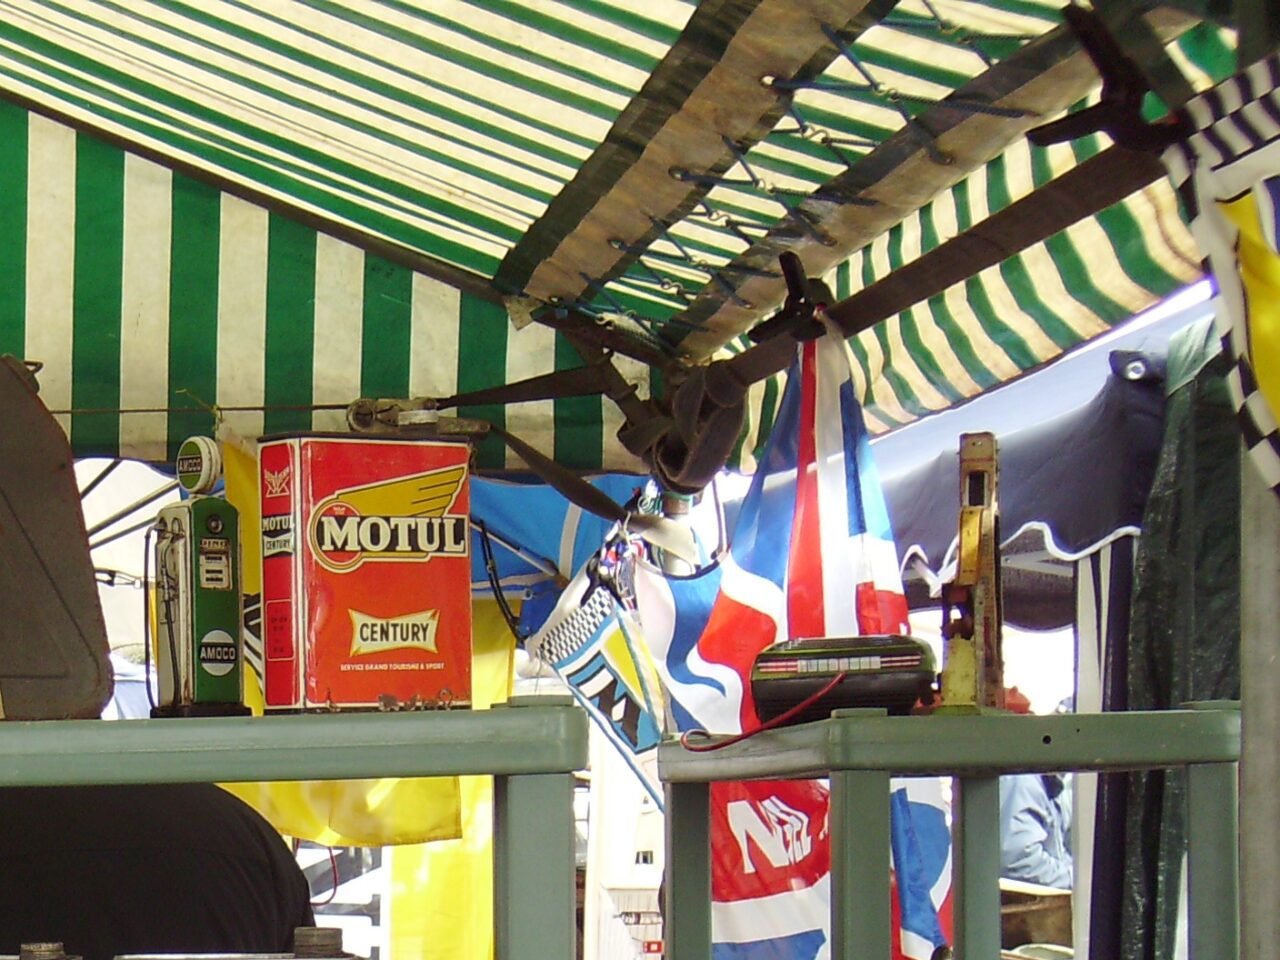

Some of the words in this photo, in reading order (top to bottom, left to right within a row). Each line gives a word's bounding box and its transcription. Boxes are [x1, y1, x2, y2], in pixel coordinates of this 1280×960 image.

[320, 517, 465, 551] MOTUL
[360, 620, 430, 643] CENTURY
[200, 647, 236, 660] AMOCO
